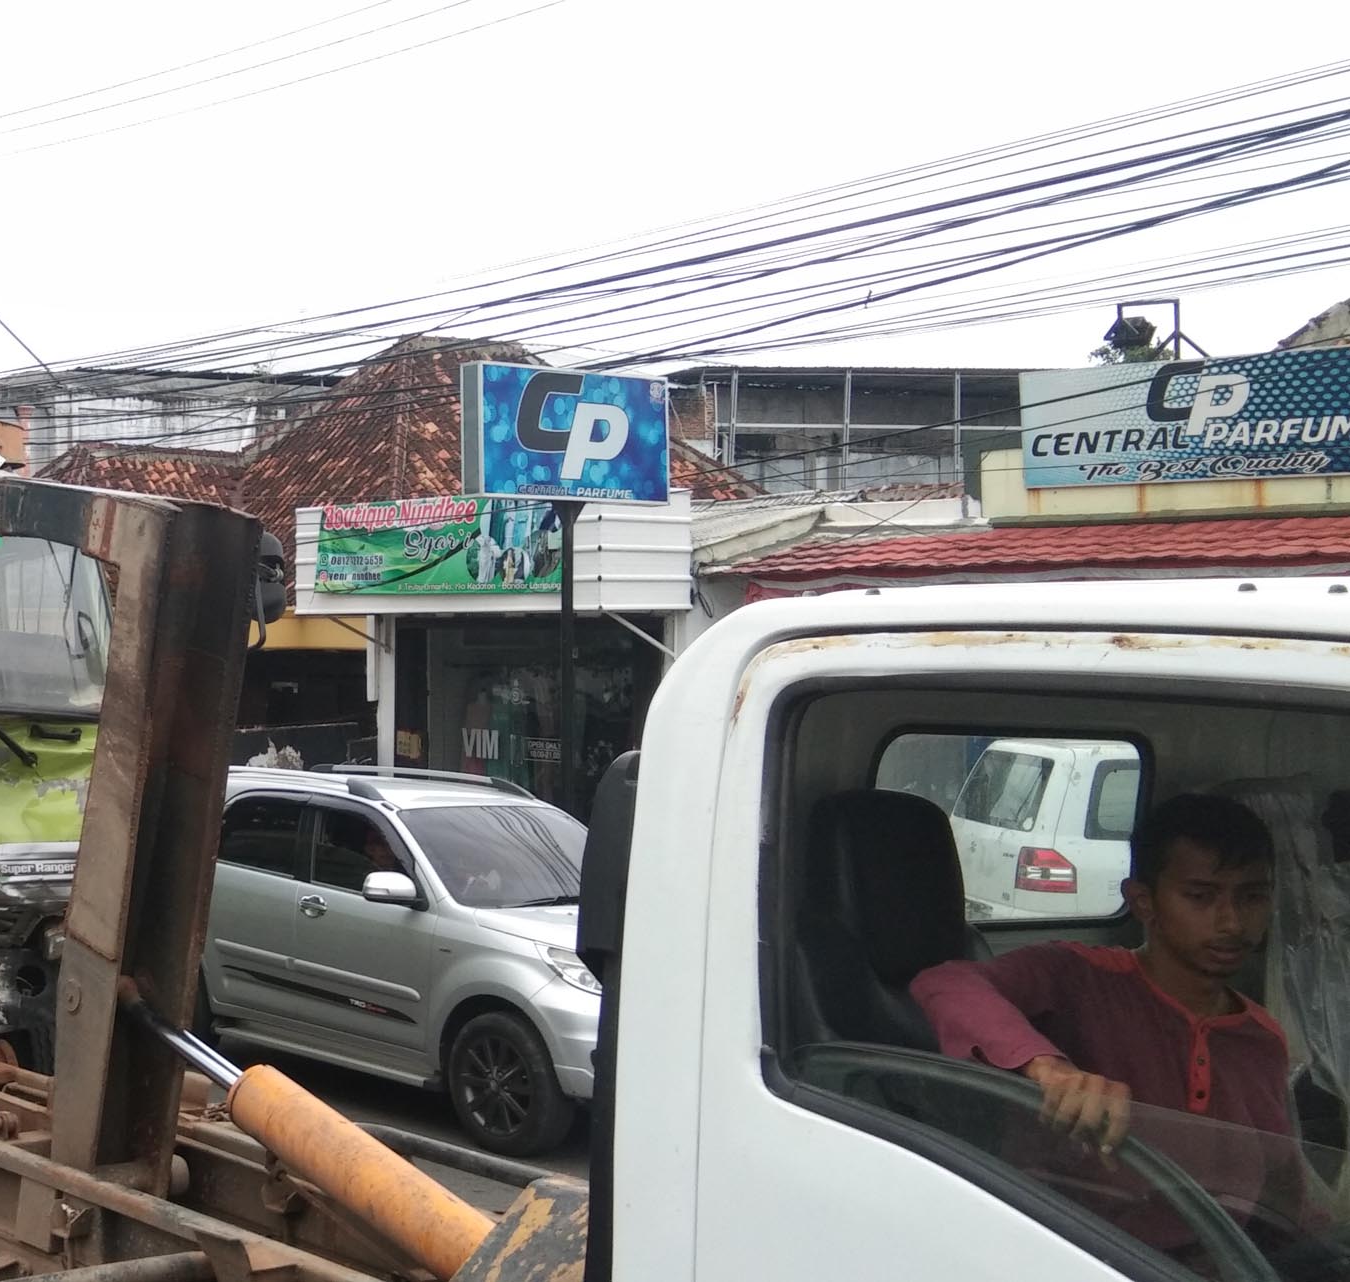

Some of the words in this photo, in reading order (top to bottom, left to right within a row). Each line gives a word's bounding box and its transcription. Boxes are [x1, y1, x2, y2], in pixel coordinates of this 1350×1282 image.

[1147, 360, 1250, 436] CP
[515, 371, 629, 480] CP
[1031, 426, 1191, 457] CENTRAL
[1079, 463, 1129, 481] The
[1138, 457, 1202, 481] Best
[1210, 451, 1330, 477] Quality
[576, 487, 633, 499] PARFUME
[323, 503, 397, 534] Boutique
[399, 496, 478, 527] Nundhee
[461, 728, 499, 760] VIM
[0, 863, 34, 875] Super
[35, 862, 76, 875] Ranger
